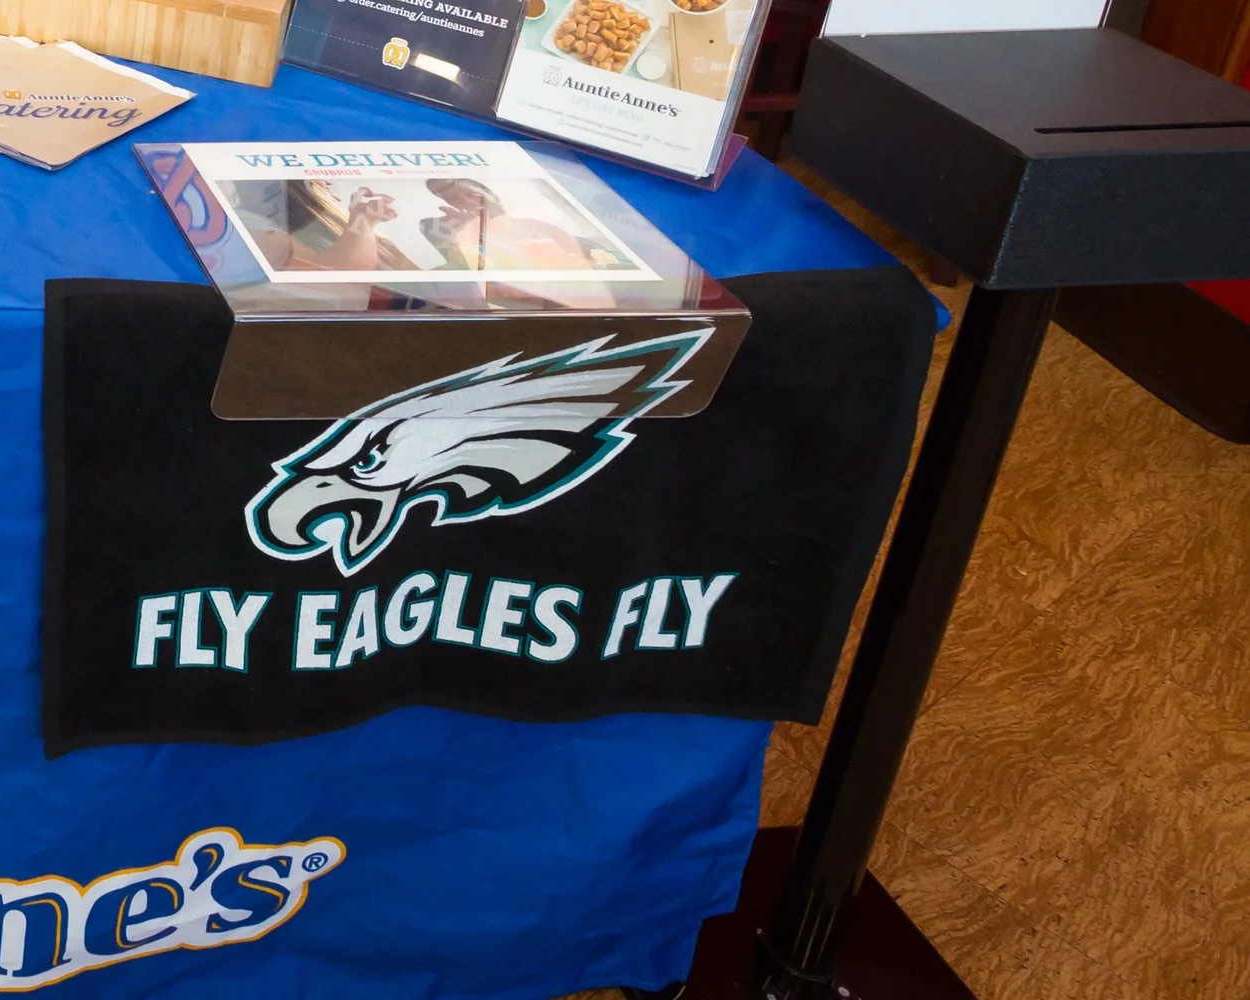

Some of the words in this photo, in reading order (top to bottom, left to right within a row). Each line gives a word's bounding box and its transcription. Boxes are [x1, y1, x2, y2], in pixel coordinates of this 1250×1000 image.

[435, 2, 509, 29] AVAILABLE
[236, 153, 304, 168] WE
[309, 153, 490, 167] DELIVER!
[132, 588, 274, 674] FLY
[291, 569, 581, 672] EAGLES
[600, 571, 741, 661] FLY
